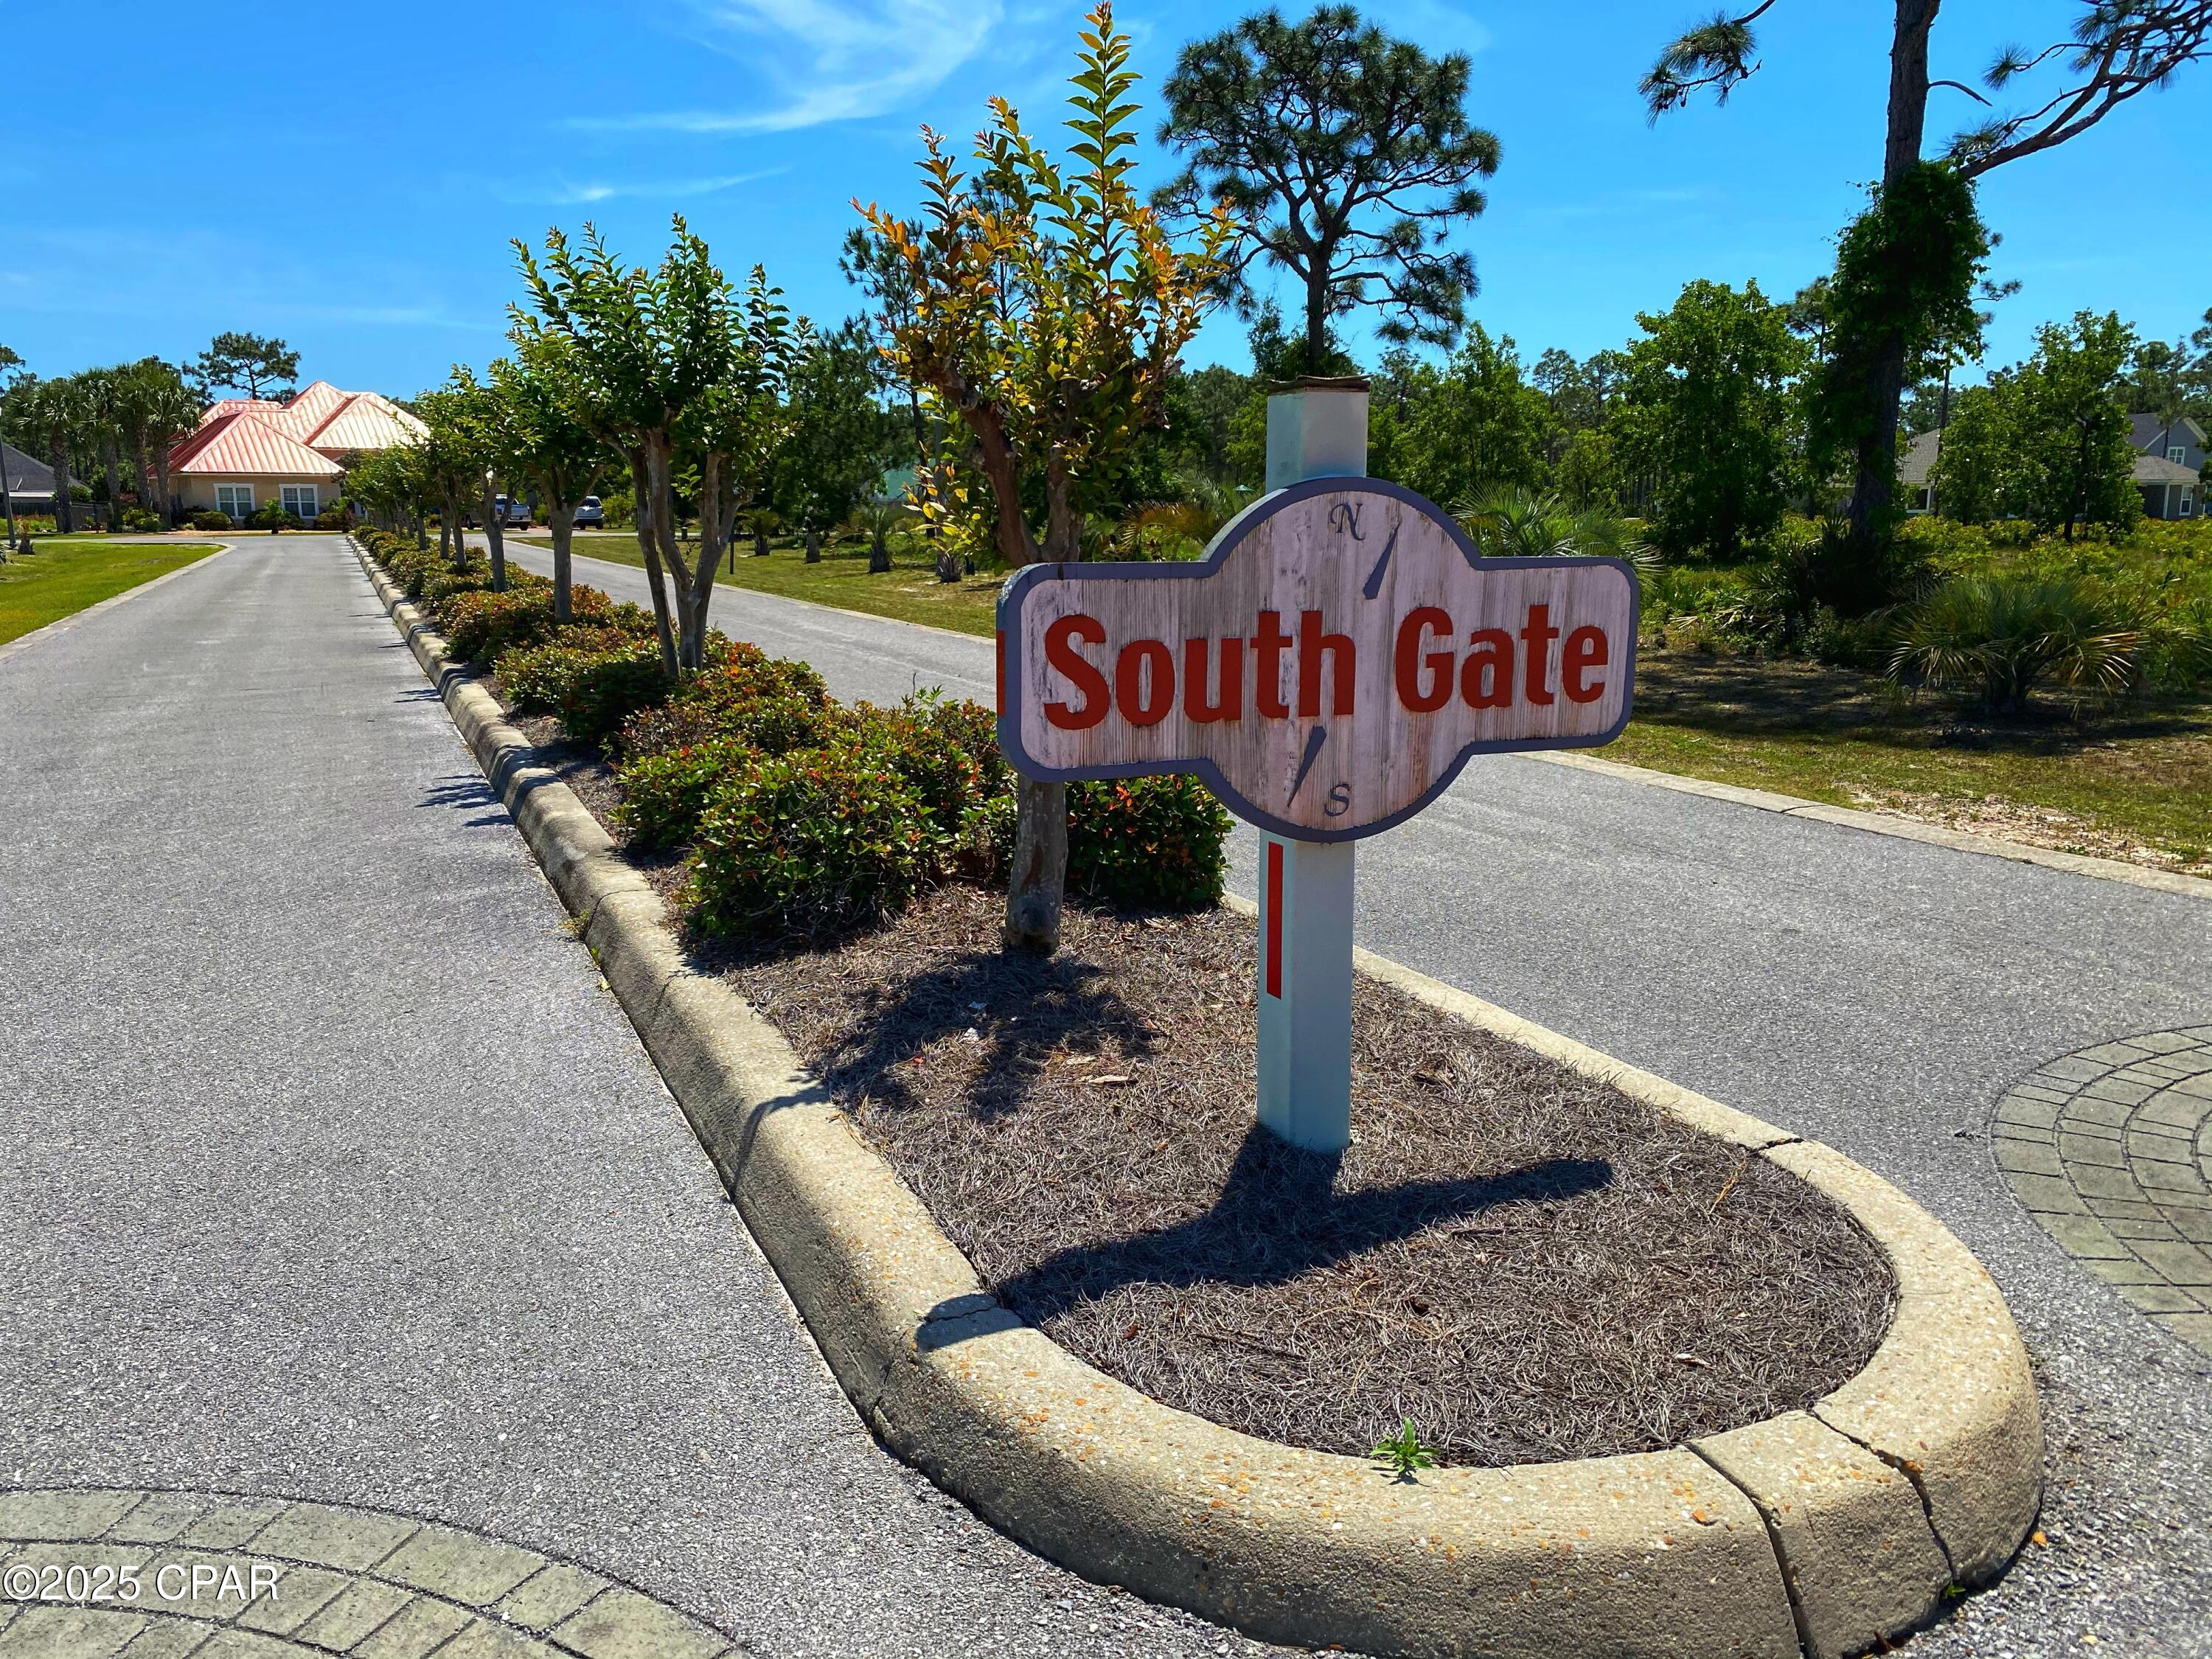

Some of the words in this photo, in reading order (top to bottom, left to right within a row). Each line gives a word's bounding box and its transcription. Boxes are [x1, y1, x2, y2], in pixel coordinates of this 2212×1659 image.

[1330, 502, 1366, 541] N
[1043, 610, 1356, 730] South
[1394, 604, 1609, 713] Gate
[1324, 783, 1351, 817] S
